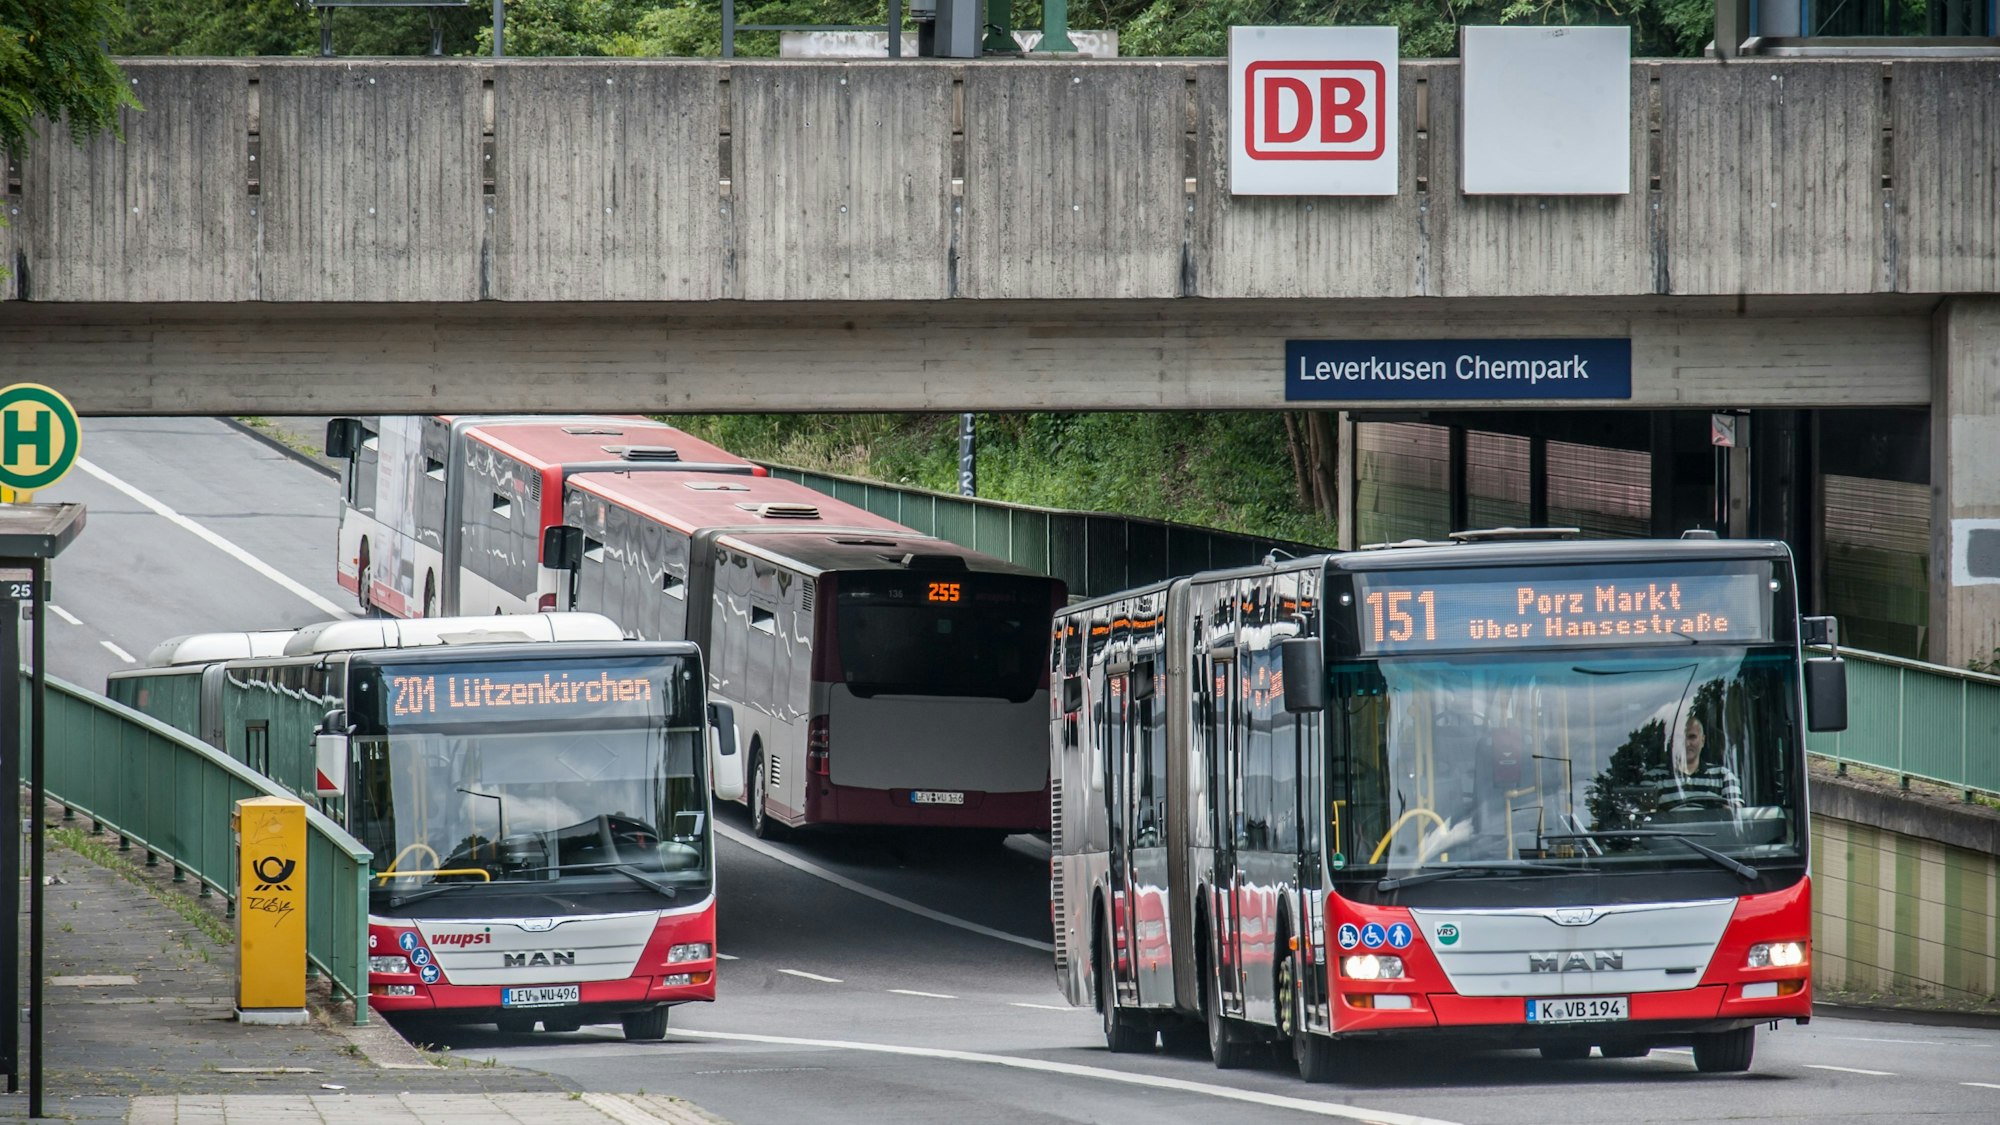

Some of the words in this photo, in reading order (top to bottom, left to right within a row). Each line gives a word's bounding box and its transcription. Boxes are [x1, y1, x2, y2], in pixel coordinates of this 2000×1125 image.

[1263, 76, 1369, 144] DB
[1299, 355, 1447, 381] Leverkusen
[1455, 354, 1590, 385] Chempark
[3, 410, 51, 466] H
[928, 583, 961, 601] 255
[1517, 587, 1584, 615] Porz
[1596, 583, 1681, 612] Markt
[1366, 589, 1436, 643] 151
[1469, 619, 1533, 640] über
[1545, 613, 1729, 637] Hansestraße
[393, 675, 436, 716] 201
[449, 672, 652, 708] Lützenkirchen
[431, 926, 492, 948] wupsi
[1436, 928, 1455, 936] VRS
[504, 950, 575, 968] MAN
[1529, 950, 1624, 973] MAN
[511, 989, 531, 1002] LEV
[1542, 1002, 1553, 1019] K
[1564, 1001, 1586, 1017] VB
[1589, 1000, 1620, 1017] 194
